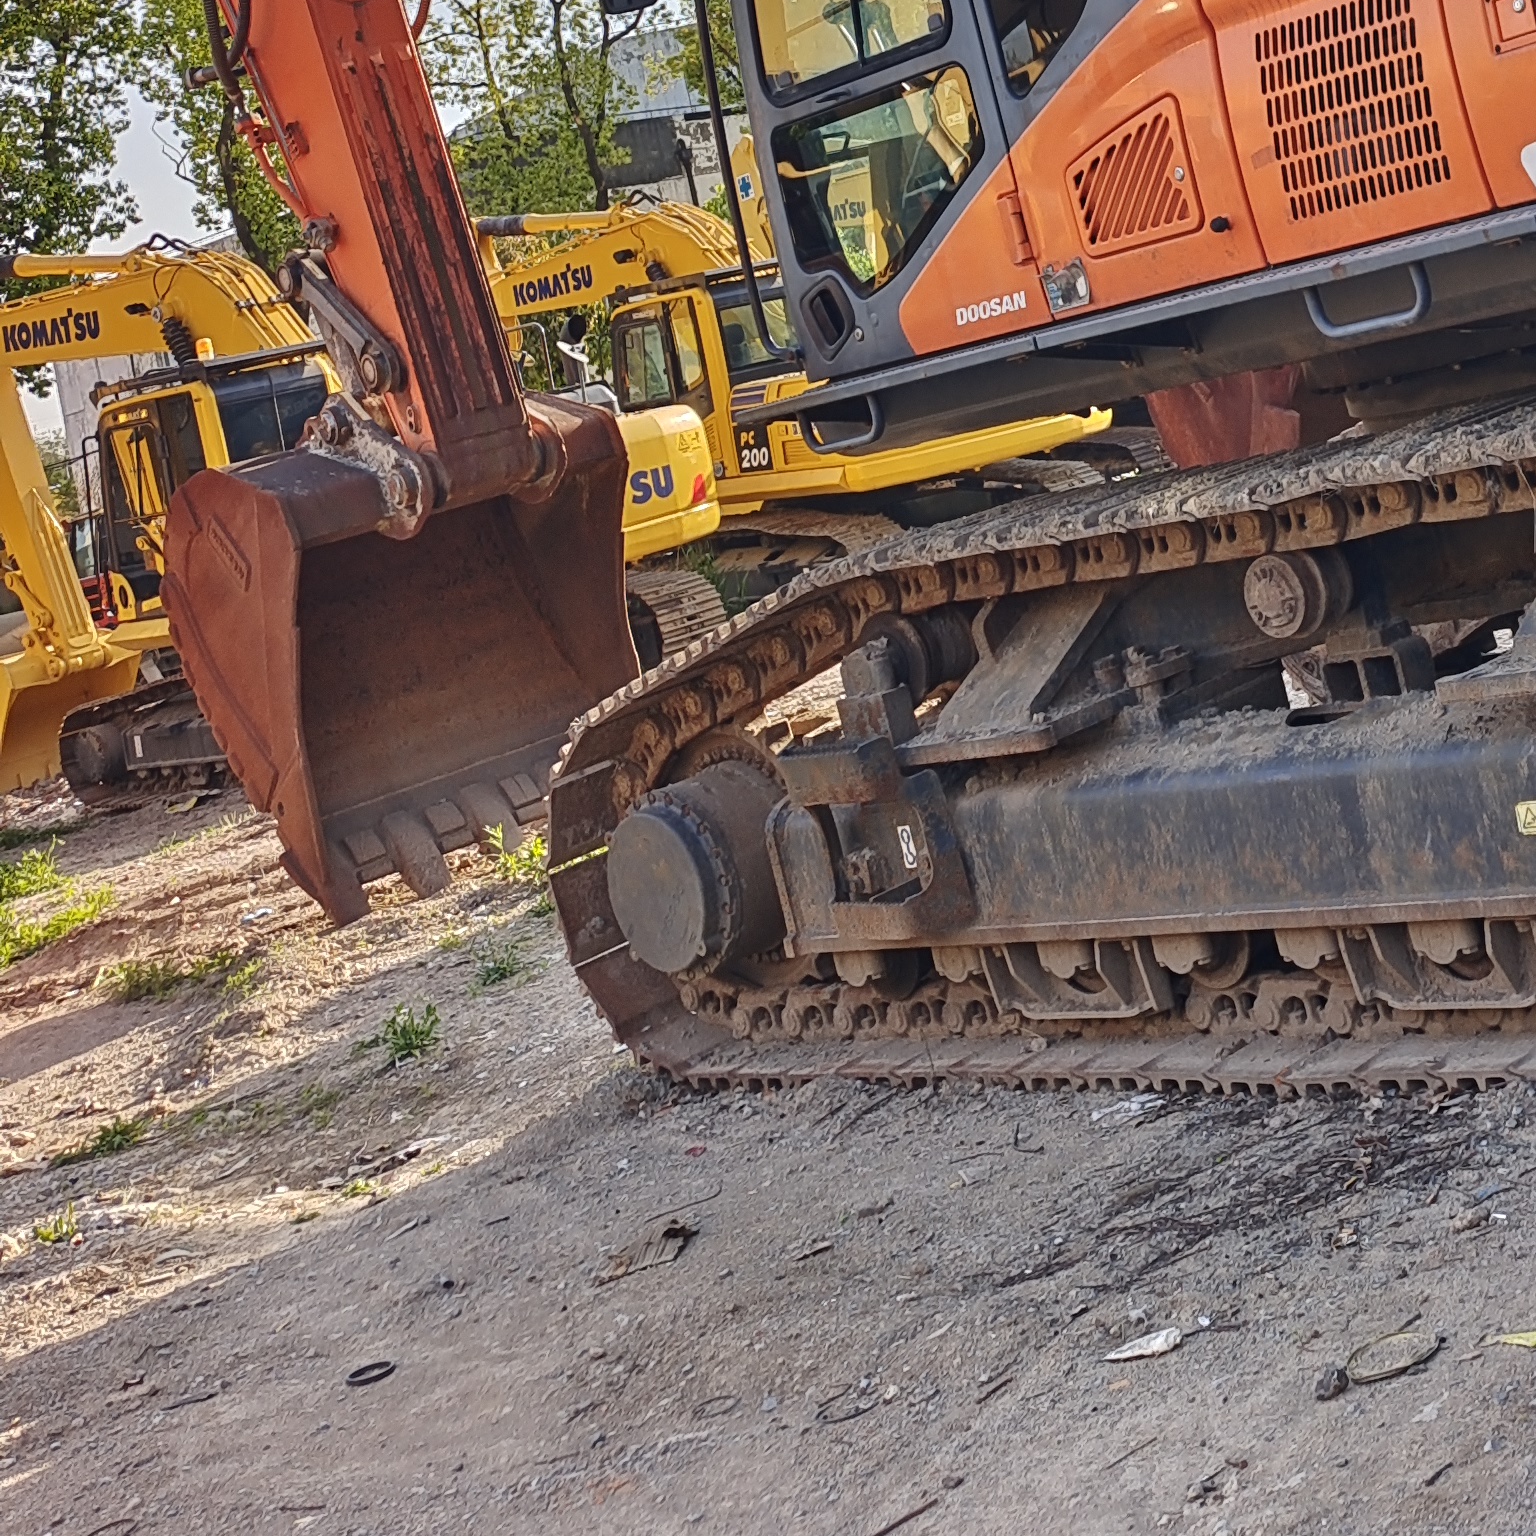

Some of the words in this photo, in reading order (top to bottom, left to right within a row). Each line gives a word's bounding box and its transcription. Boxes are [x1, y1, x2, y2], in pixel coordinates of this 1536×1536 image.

[512, 263, 593, 308] KOMATSU
[955, 290, 1027, 327] DOOSAN
[2, 307, 100, 353] KOMATSU
[740, 430, 755, 447] PC
[741, 447, 769, 469] 200
[630, 464, 674, 504] SU
